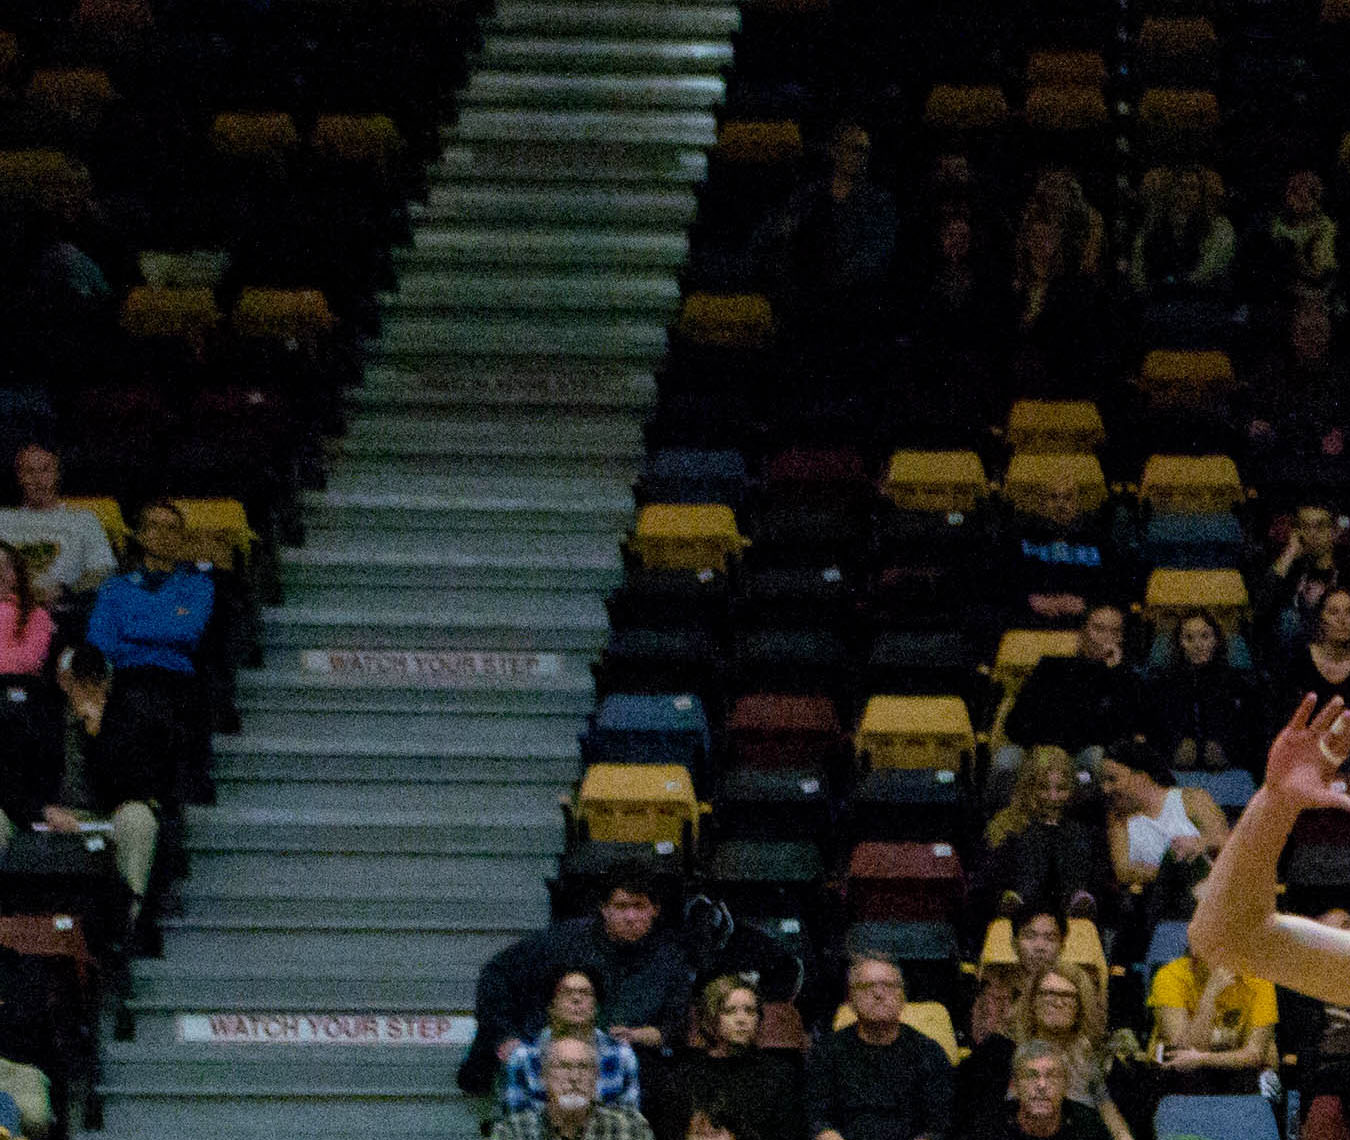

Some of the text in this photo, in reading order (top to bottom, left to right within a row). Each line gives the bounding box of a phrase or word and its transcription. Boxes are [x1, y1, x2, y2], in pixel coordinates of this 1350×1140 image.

[209, 1014, 451, 1039] WATCH YOUR STEP
